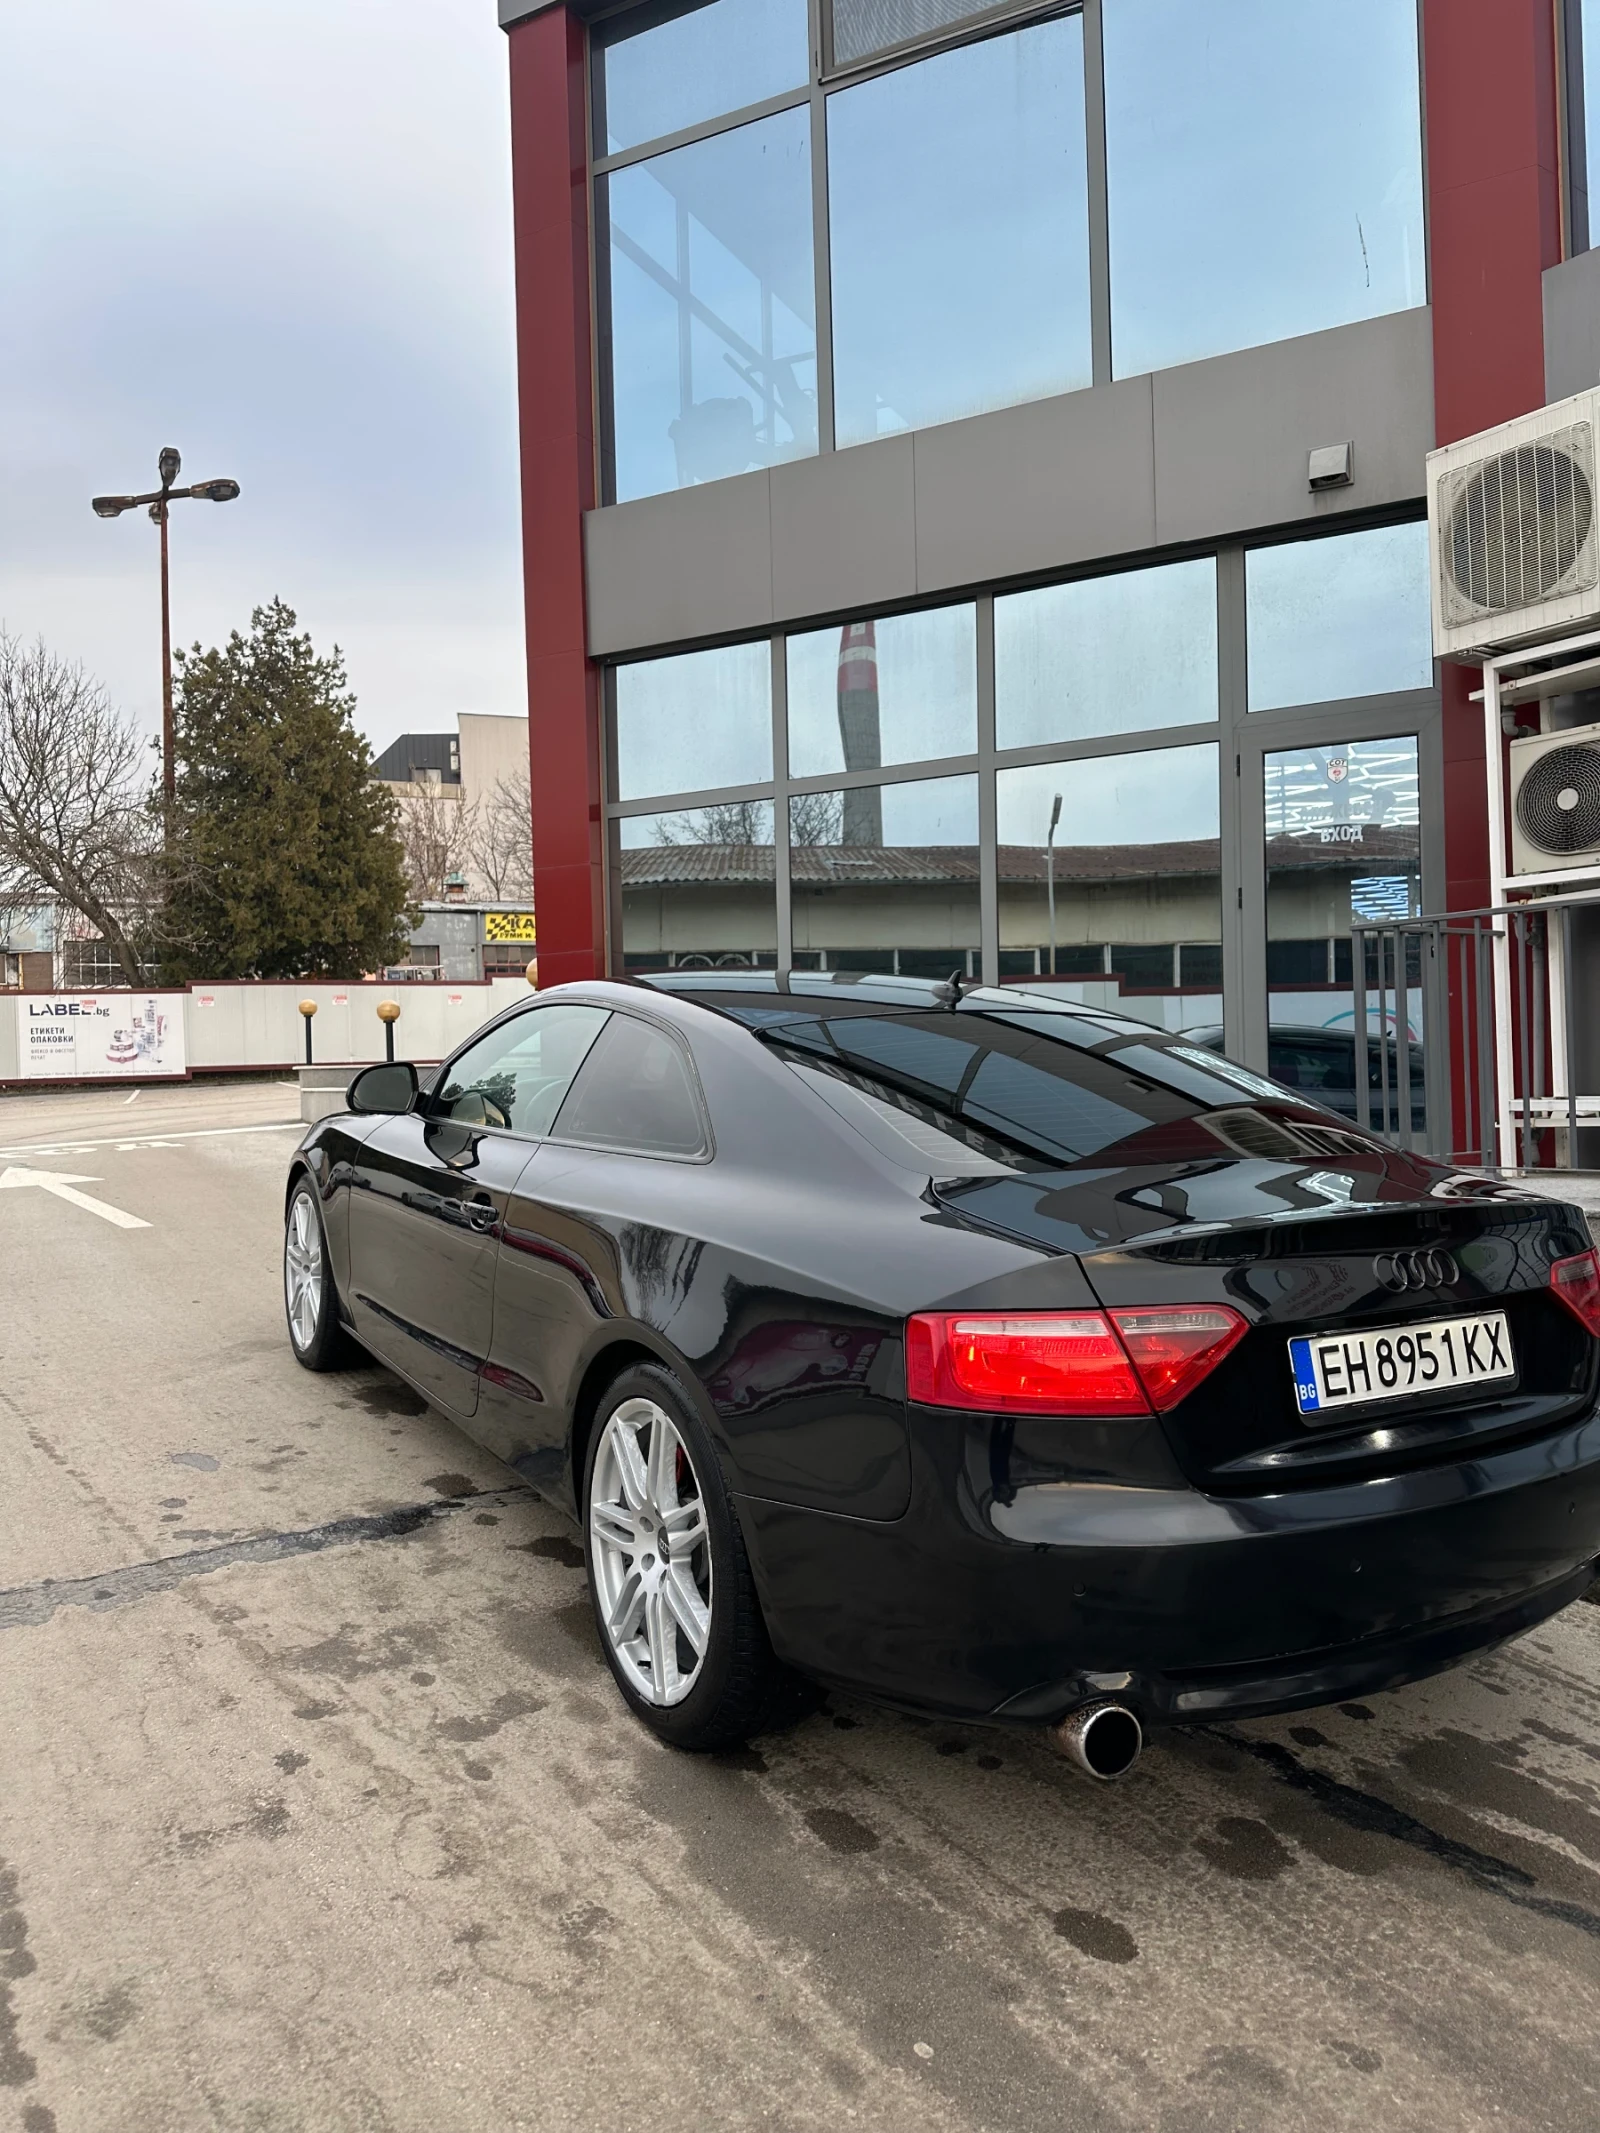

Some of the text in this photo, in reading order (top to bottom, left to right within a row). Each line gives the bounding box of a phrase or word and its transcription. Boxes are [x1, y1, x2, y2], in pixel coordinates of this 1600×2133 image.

[1320, 824, 1364, 843] ВХОД
[30, 1027, 65, 1035] ЕТИКЕТИ
[30, 1035, 74, 1044] ОПАКОВКИ
[1300, 1384, 1316, 1400] BG
